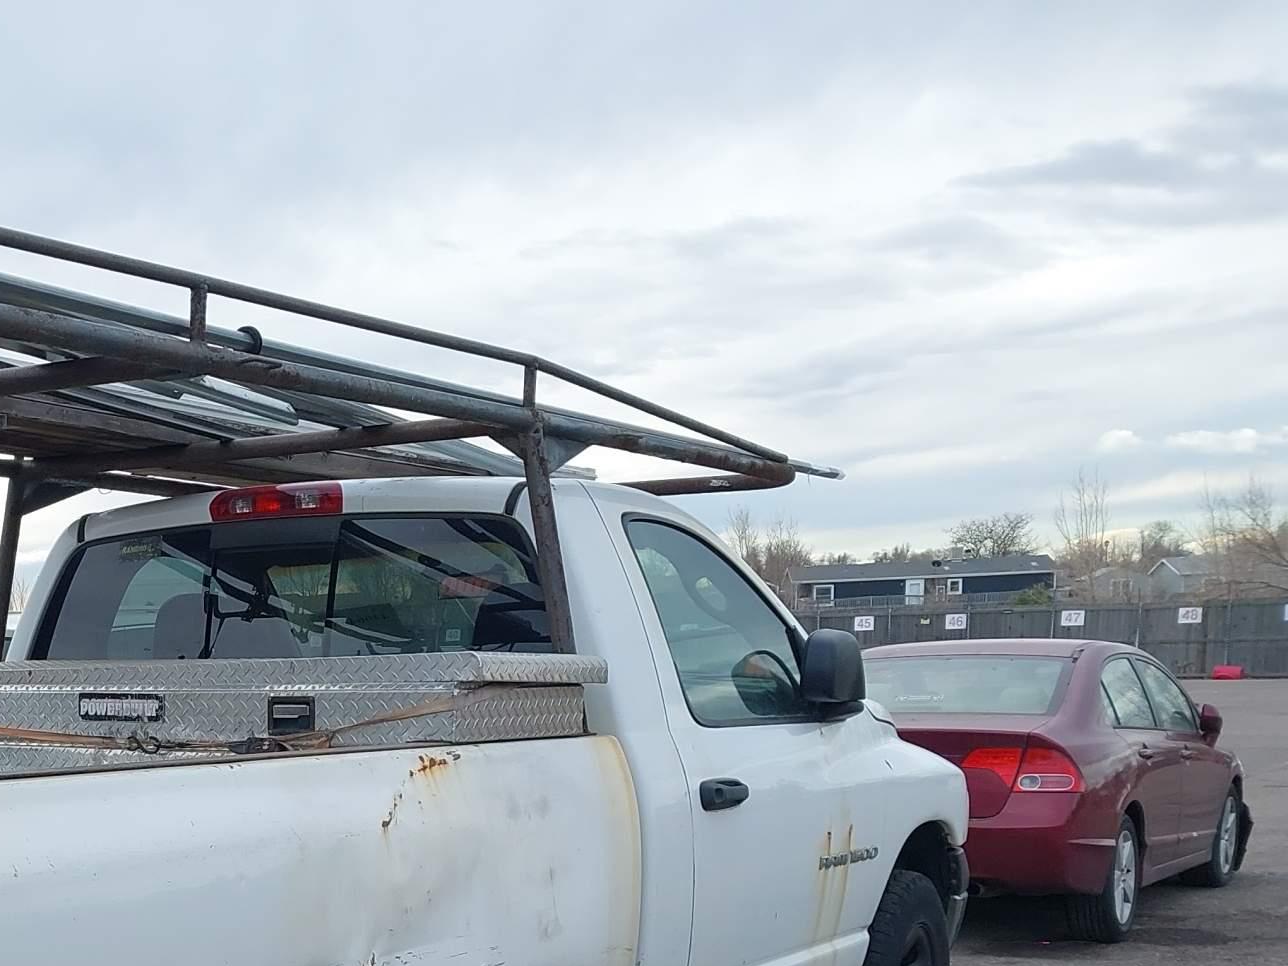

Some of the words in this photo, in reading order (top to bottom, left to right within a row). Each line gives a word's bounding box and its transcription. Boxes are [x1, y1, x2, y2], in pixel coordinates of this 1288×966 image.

[1064, 612, 1081, 623] 47
[1182, 609, 1198, 621] 48
[856, 618, 872, 629] 45
[948, 616, 963, 627] 46
